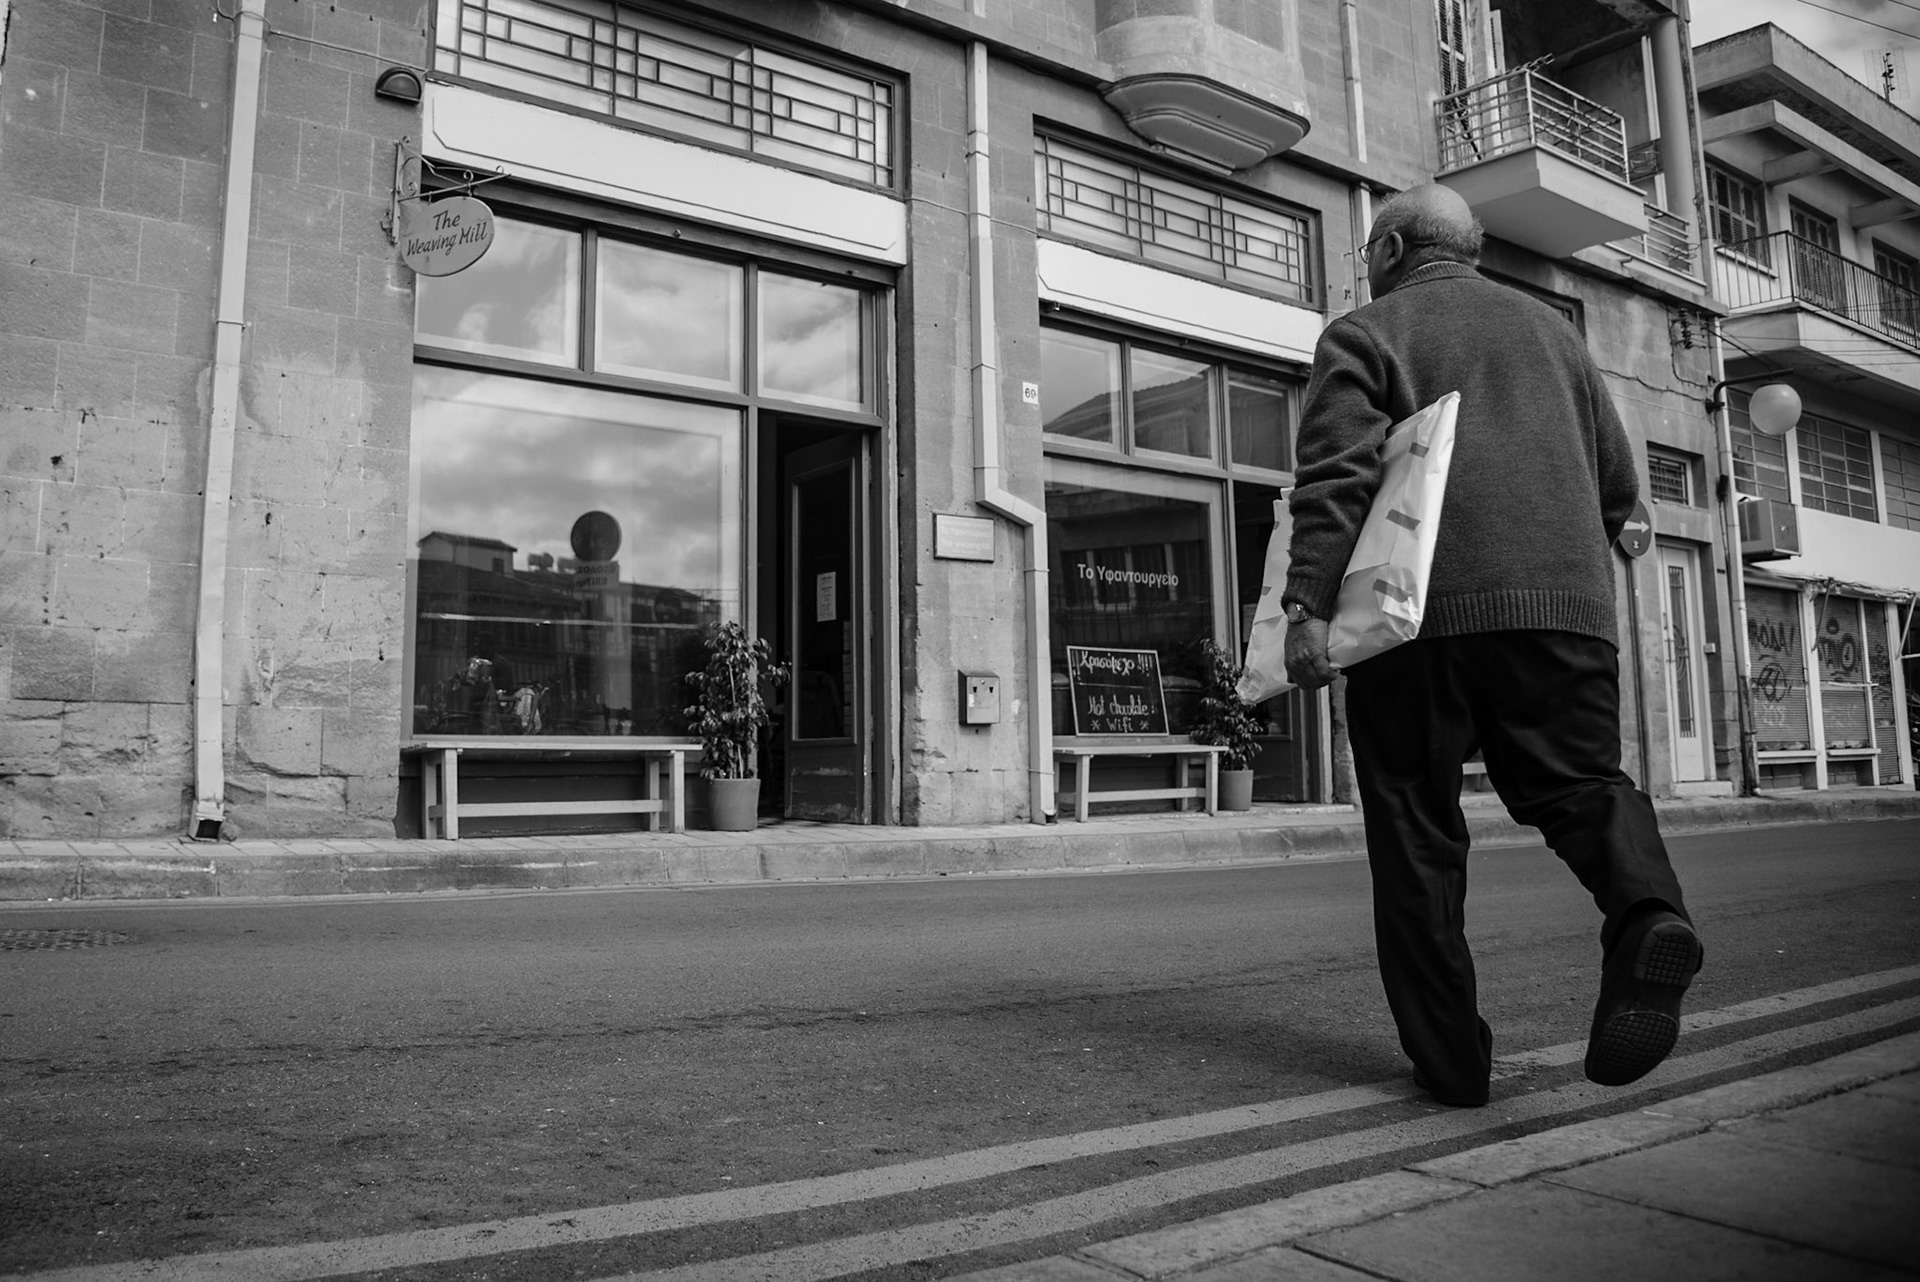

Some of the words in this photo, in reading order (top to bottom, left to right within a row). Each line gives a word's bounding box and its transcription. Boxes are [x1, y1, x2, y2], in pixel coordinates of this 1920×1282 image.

[433, 210, 461, 231] The
[406, 234, 457, 256] Weaving
[458, 221, 488, 245] Mill
[1025, 387, 1036, 399] 69
[1077, 563, 1094, 580] Το
